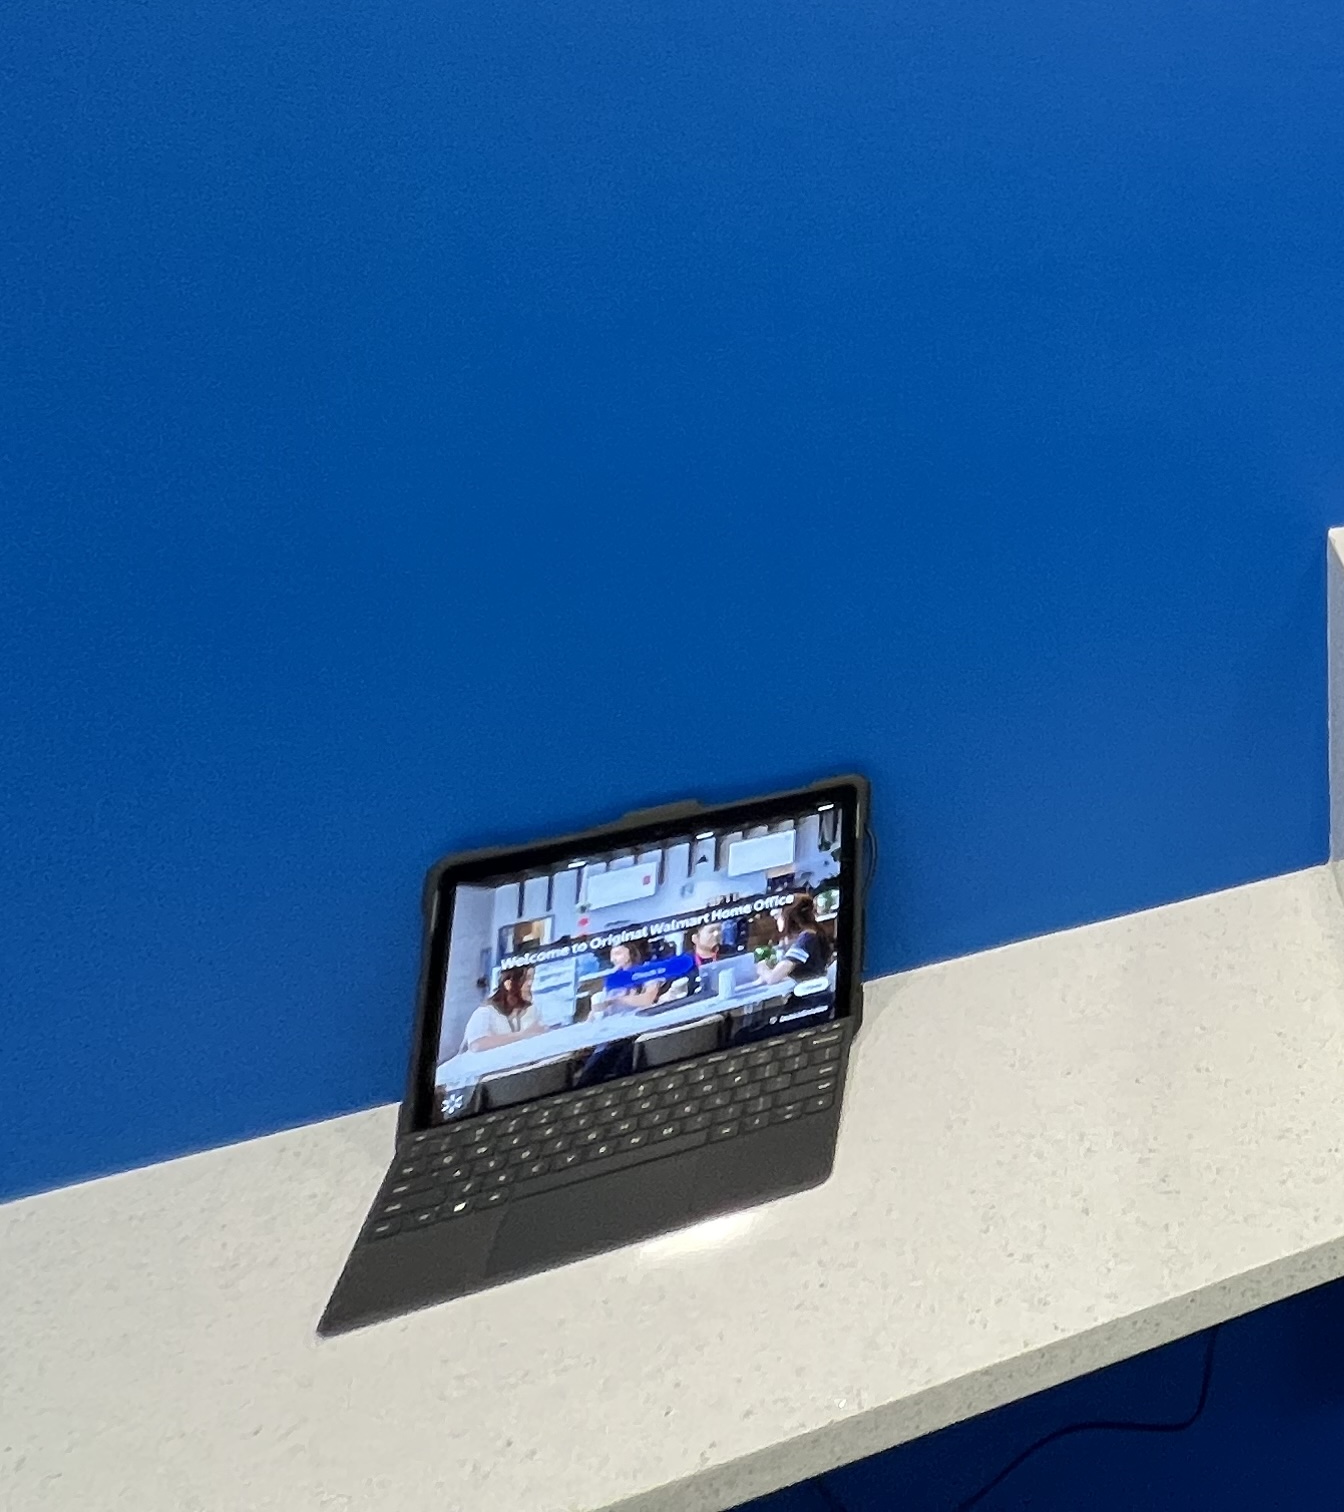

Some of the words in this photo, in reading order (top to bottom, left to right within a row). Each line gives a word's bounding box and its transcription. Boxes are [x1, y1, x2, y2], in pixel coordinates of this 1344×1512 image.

[501, 946, 570, 971] Welcome
[572, 939, 587, 954] to
[590, 925, 648, 951] Original
[650, 912, 709, 935] Walmart
[711, 904, 752, 922] Home
[754, 893, 795, 912] Office
